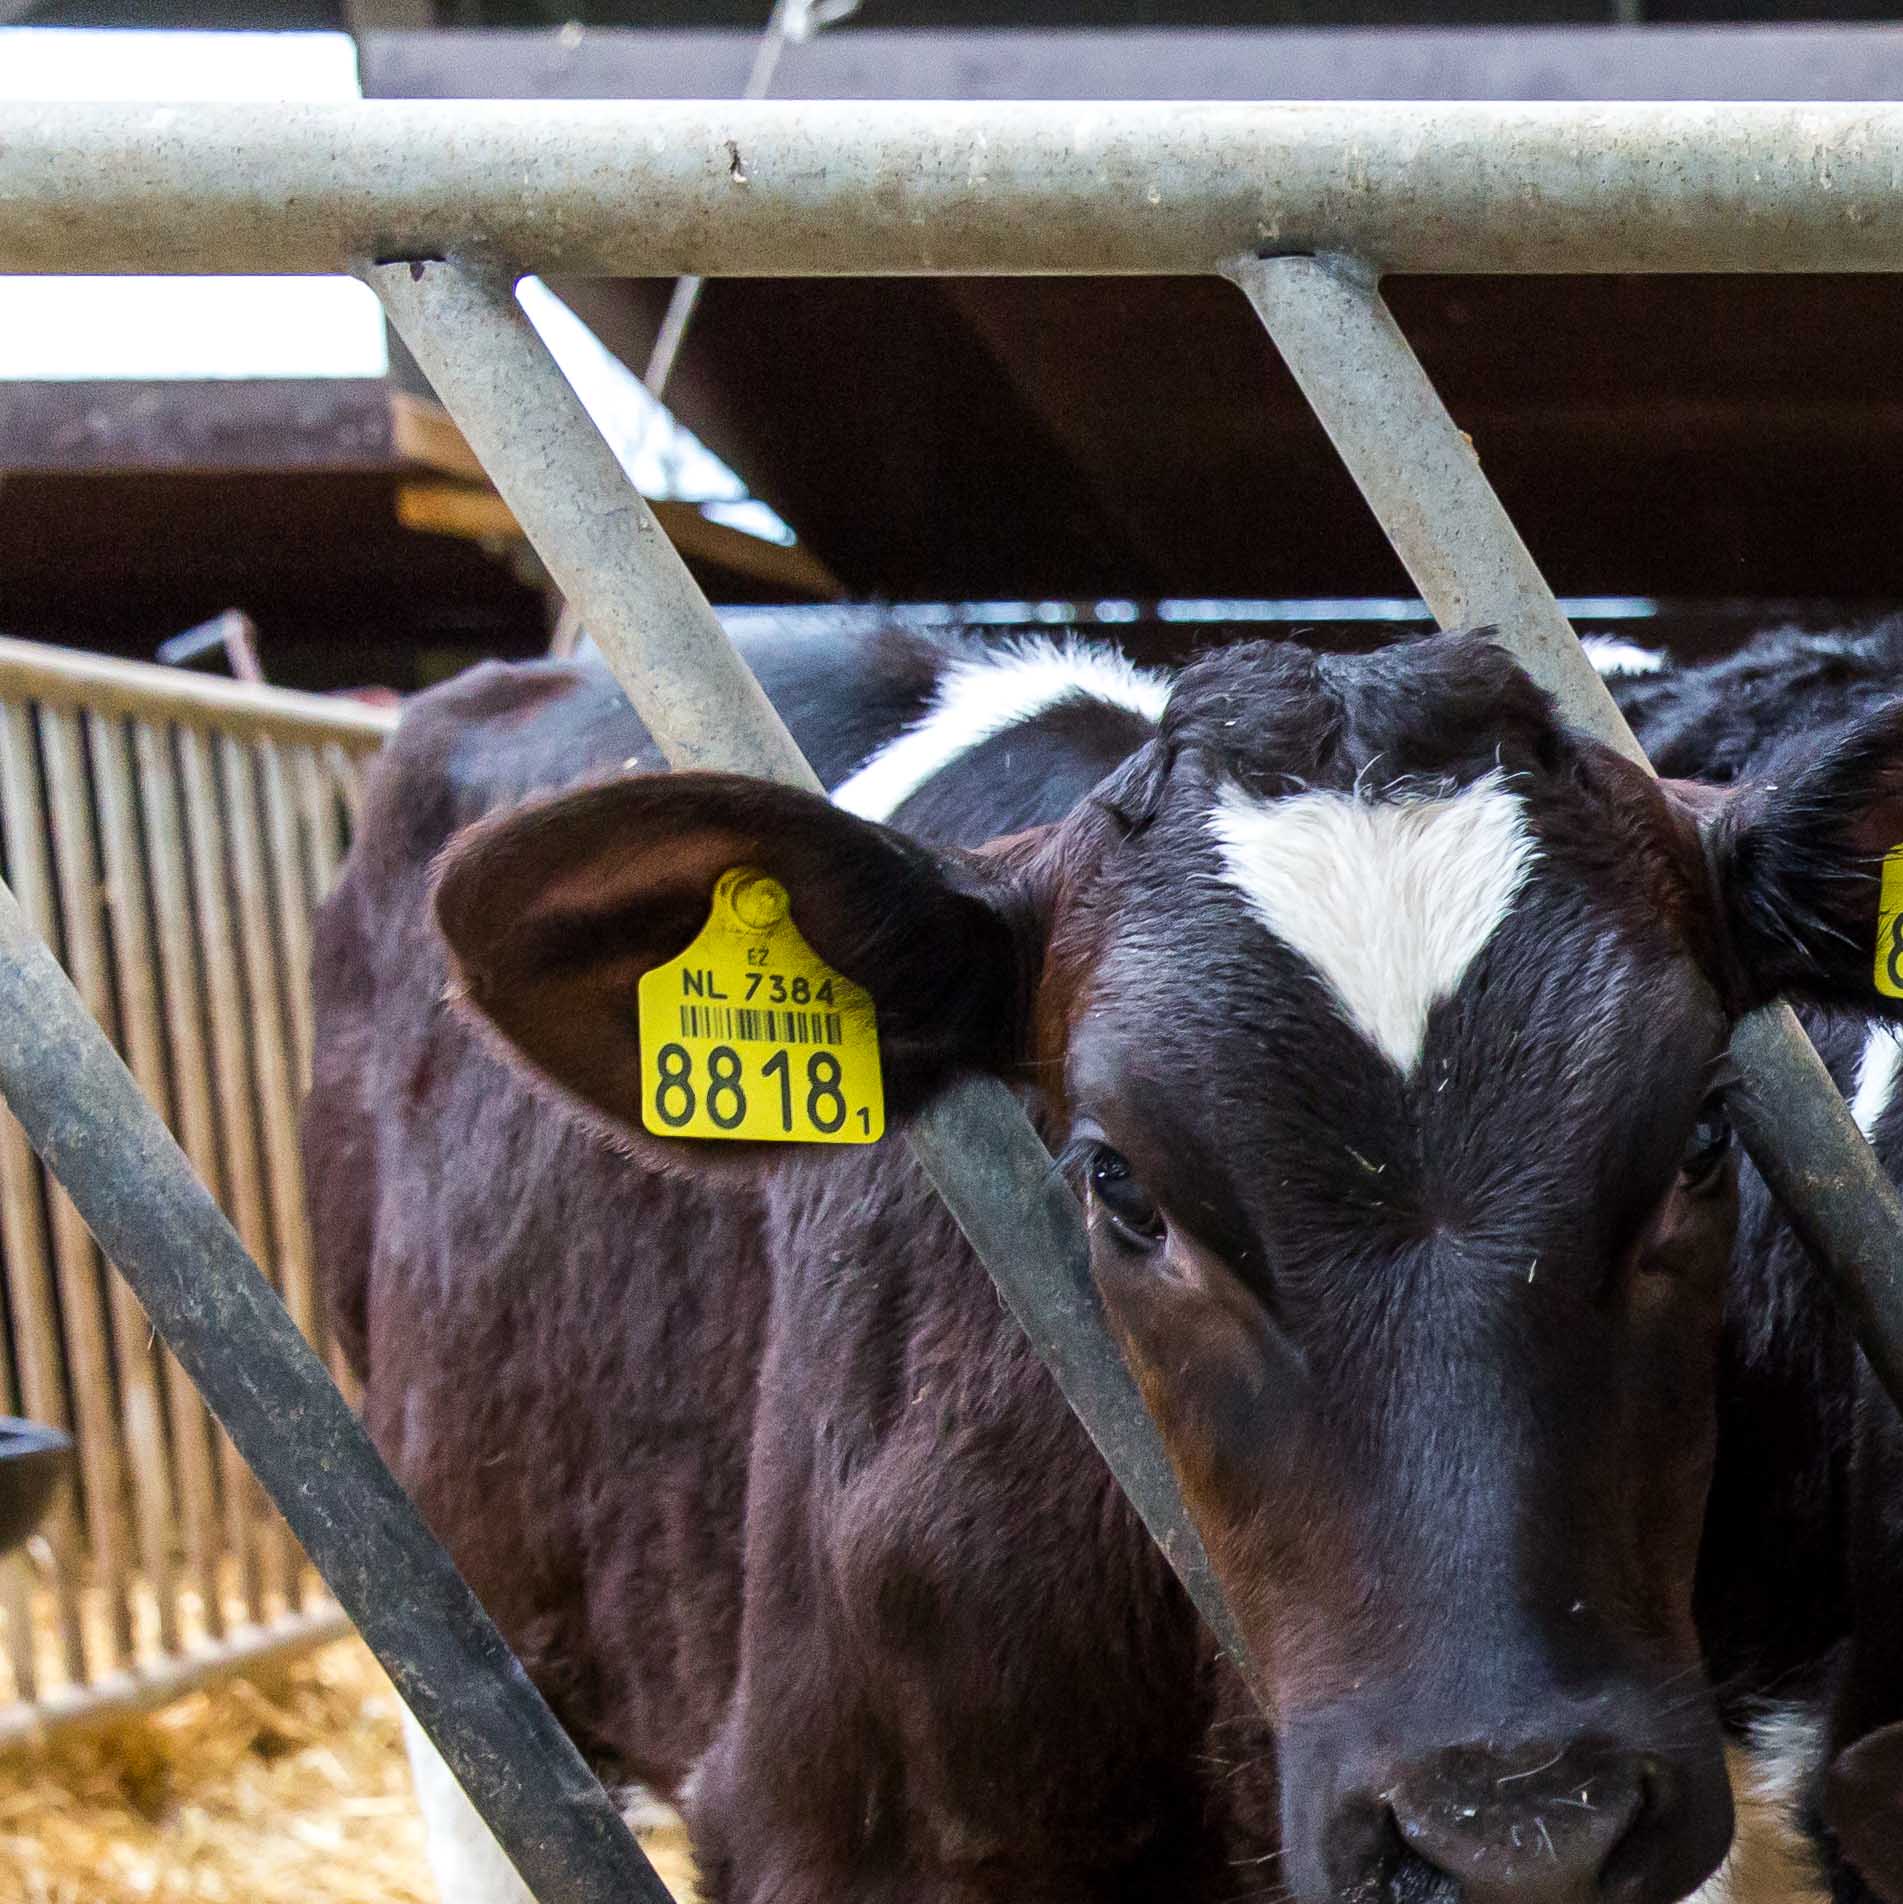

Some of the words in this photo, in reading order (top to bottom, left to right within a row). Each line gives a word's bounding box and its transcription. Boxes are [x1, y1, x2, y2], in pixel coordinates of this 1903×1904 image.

[747, 947, 770, 966] EZ
[682, 967, 728, 1000] NL
[744, 972, 835, 1006] 7384
[655, 1042, 847, 1135] 8818
[856, 1106, 871, 1136] 1
